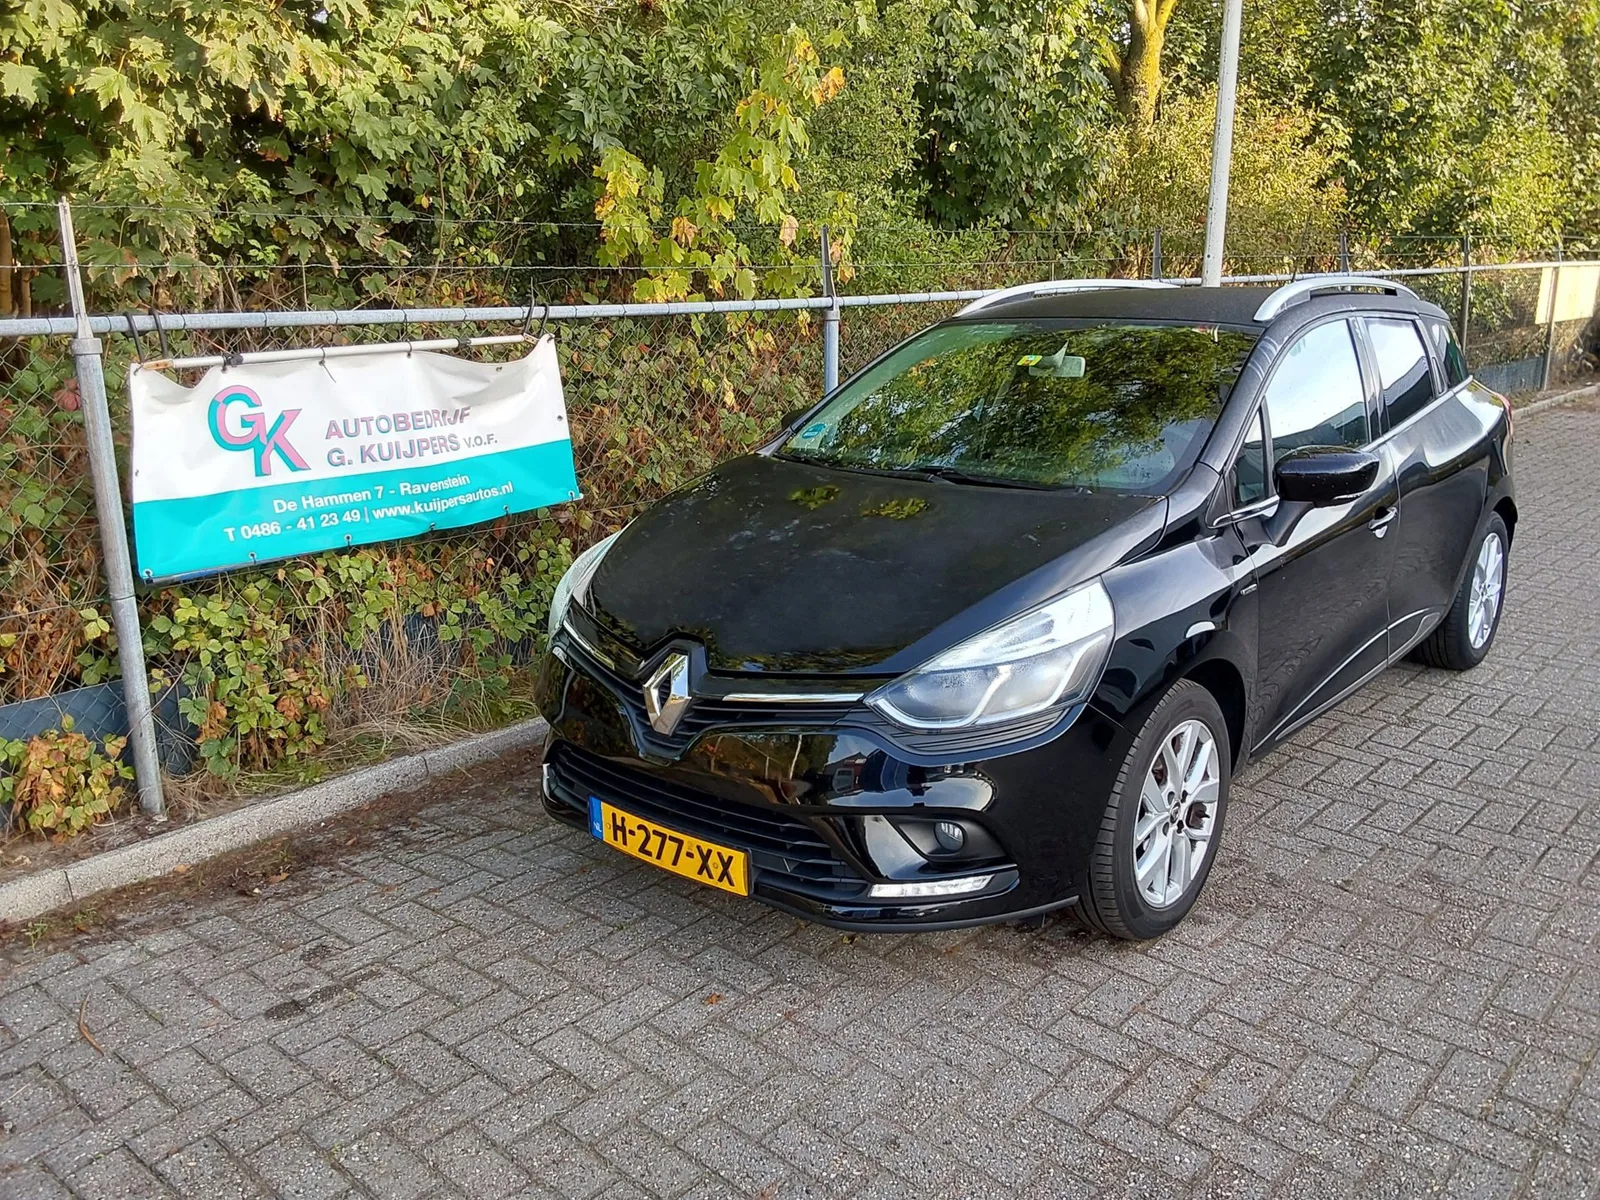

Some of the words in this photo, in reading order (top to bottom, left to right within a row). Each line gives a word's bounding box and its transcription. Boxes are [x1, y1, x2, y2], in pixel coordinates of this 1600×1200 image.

[324, 406, 471, 440] AUTOBEDRIJF
[326, 447, 353, 467] G.
[360, 433, 461, 464] KUIJPERS
[463, 433, 498, 449] V.O.F.
[223, 527, 236, 542] T
[240, 521, 281, 540] 0486
[296, 517, 316, 531] 41
[319, 512, 340, 528] 23
[342, 509, 361, 524] 49
[372, 481, 514, 519] www.kuijpersautos.nl
[272, 499, 298, 514] De
[301, 490, 372, 509] Hammen
[374, 485, 384, 499] 7
[399, 474, 471, 496] Ravenstein
[611, 812, 735, 887] H-277-XX
